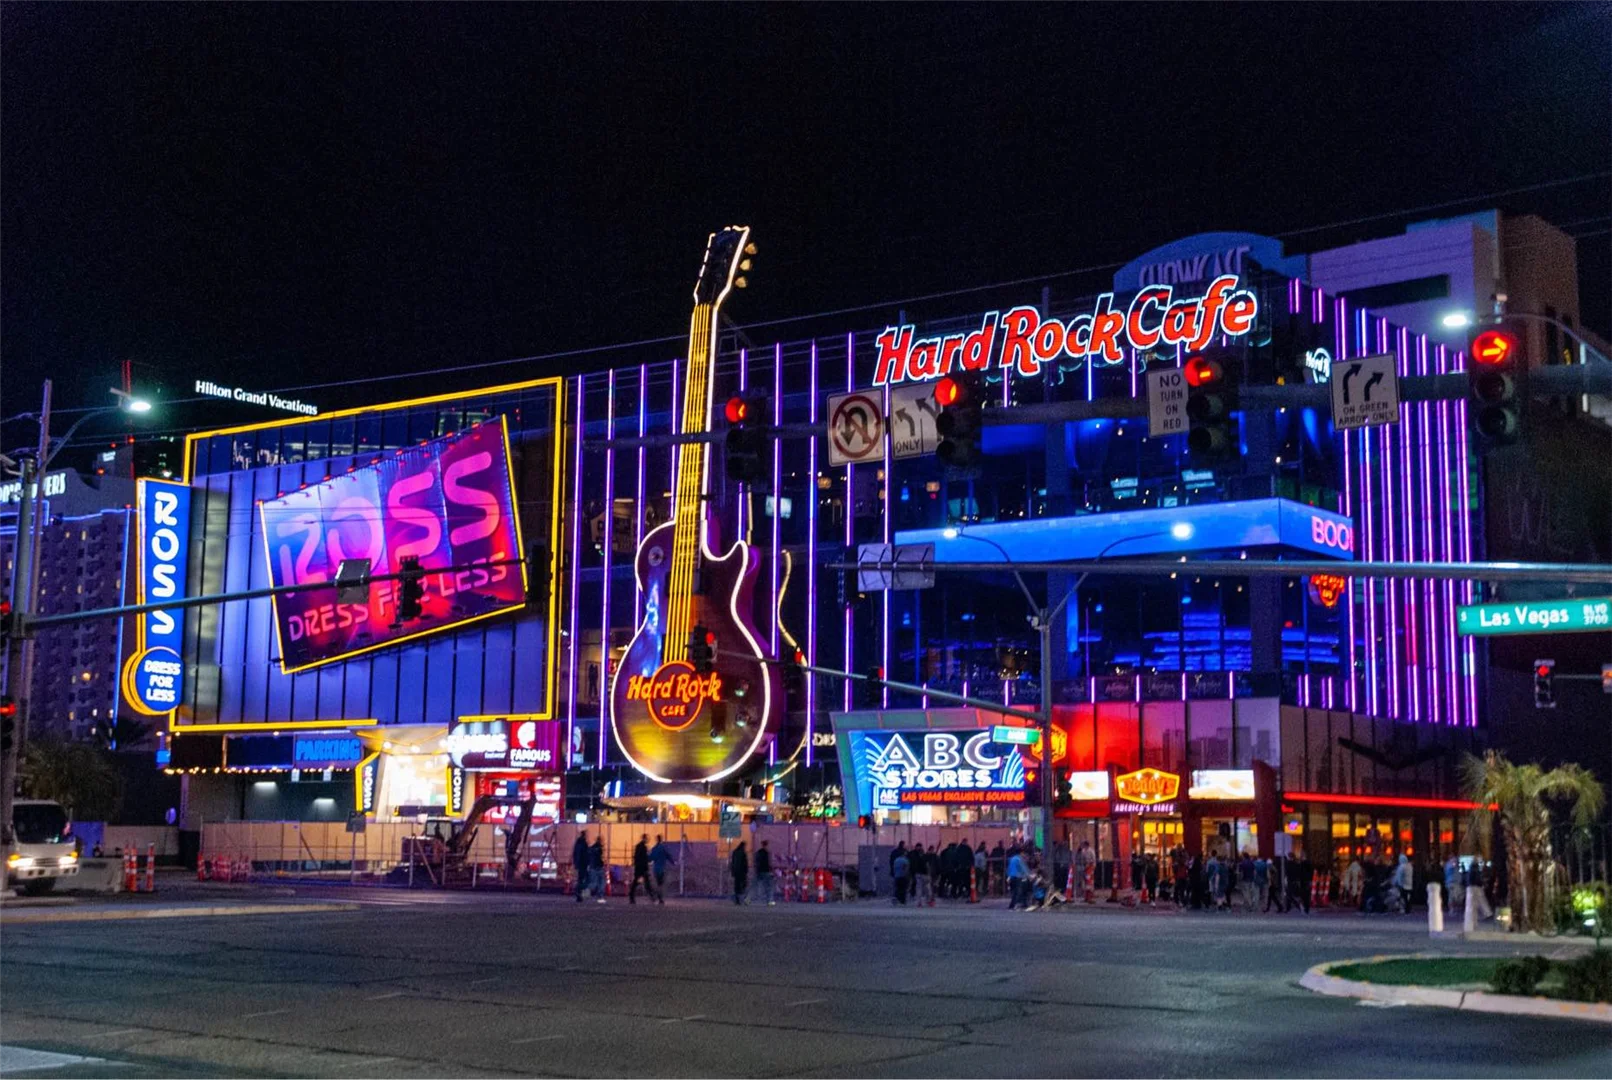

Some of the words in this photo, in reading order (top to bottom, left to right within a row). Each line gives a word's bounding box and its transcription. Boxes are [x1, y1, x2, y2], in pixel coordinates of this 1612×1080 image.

[872, 310, 999, 386] Hard
[999, 292, 1124, 377] Rock
[1127, 274, 1257, 352] Cafe
[1160, 374, 1181, 388] NO
[195, 380, 232, 399] Hilton
[233, 388, 267, 406] Grand
[268, 394, 318, 415] Vacations
[1161, 388, 1183, 401] TURN
[1165, 404, 1178, 415] ON
[1343, 405, 1355, 415] ON
[1359, 401, 1389, 412] GREEN
[1163, 418, 1182, 431] RED
[1338, 414, 1369, 426] ARROW
[1372, 410, 1395, 421] ONLY
[895, 439, 920, 453] ONLY
[276, 450, 500, 598] ROSS
[151, 490, 180, 635] ROSS
[287, 603, 369, 642] DRESS
[438, 551, 507, 597] LESS
[1460, 611, 1468, 622] S
[1479, 607, 1511, 628] Las
[1514, 605, 1570, 629] Vegas
[1582, 602, 1608, 615] BLVD
[1583, 613, 1609, 625] 3700
[149, 674, 174, 689] FOR
[626, 673, 676, 700] Hard
[675, 671, 722, 703] Rock
[145, 687, 176, 703] LESS
[661, 705, 686, 717] CAFE
[295, 738, 362, 762] PARKING
[510, 747, 552, 763] FAMOUS
[872, 731, 1001, 771] ABC
[884, 768, 993, 789] STORES
[362, 764, 375, 810] ROSS
[880, 788, 899, 799] ABC
[901, 791, 917, 802] LAS
